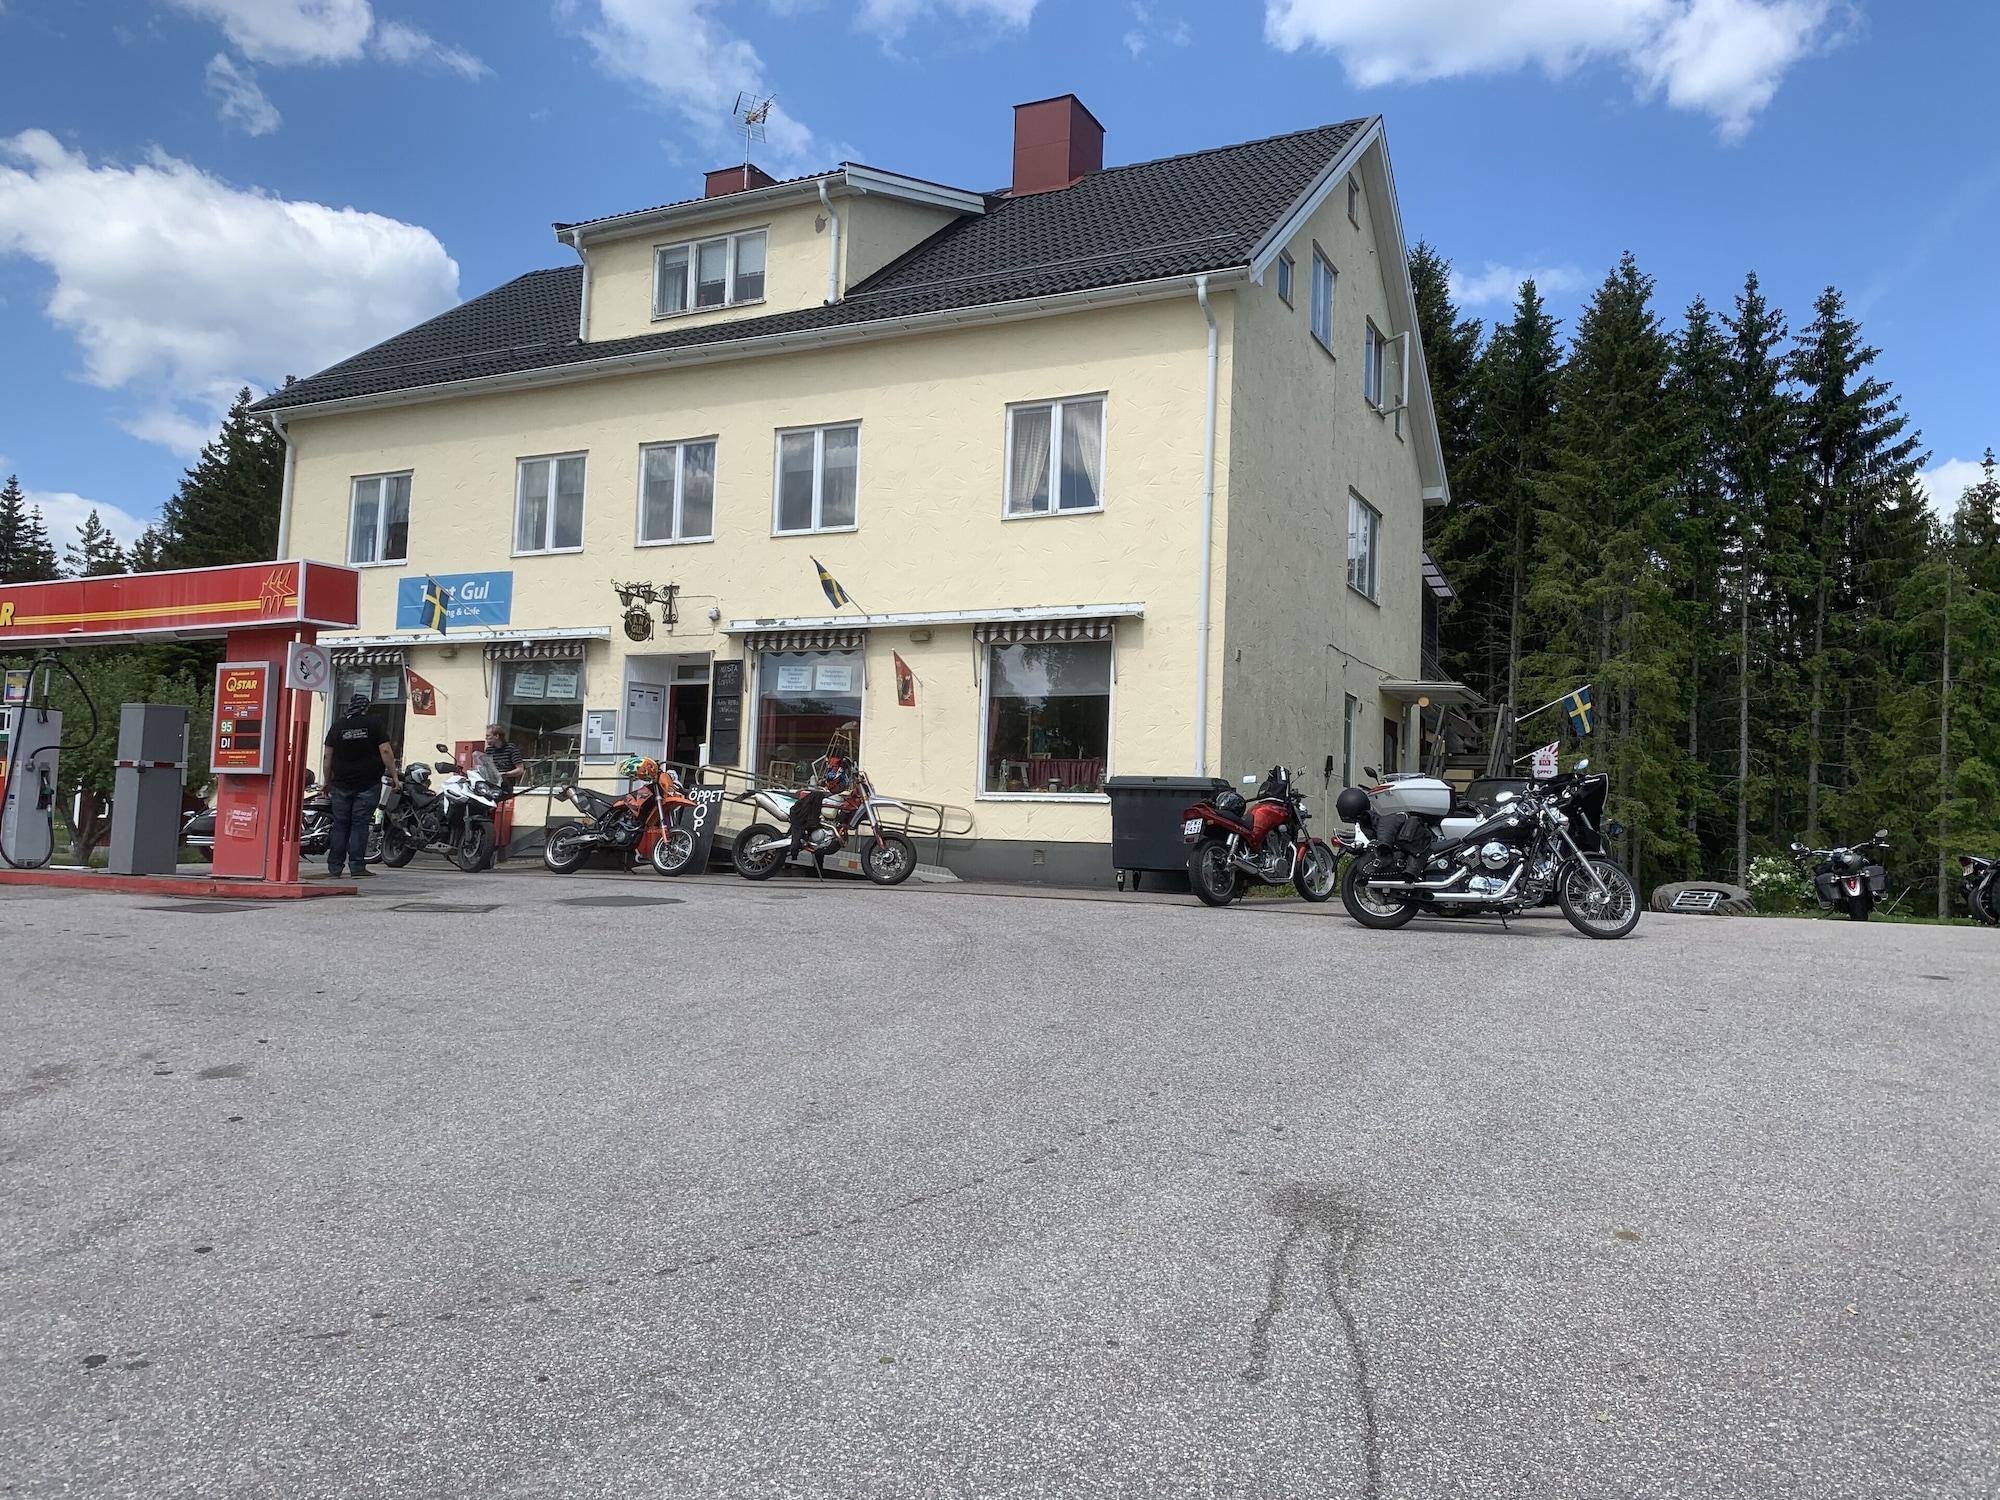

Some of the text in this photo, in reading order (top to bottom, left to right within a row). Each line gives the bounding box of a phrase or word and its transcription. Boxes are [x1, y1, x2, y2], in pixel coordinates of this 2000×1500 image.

[420, 581, 490, 602] Tt Gul
[221, 721, 233, 732] 95
[221, 737, 231, 748] DI
[688, 787, 725, 802] ÖPPET
